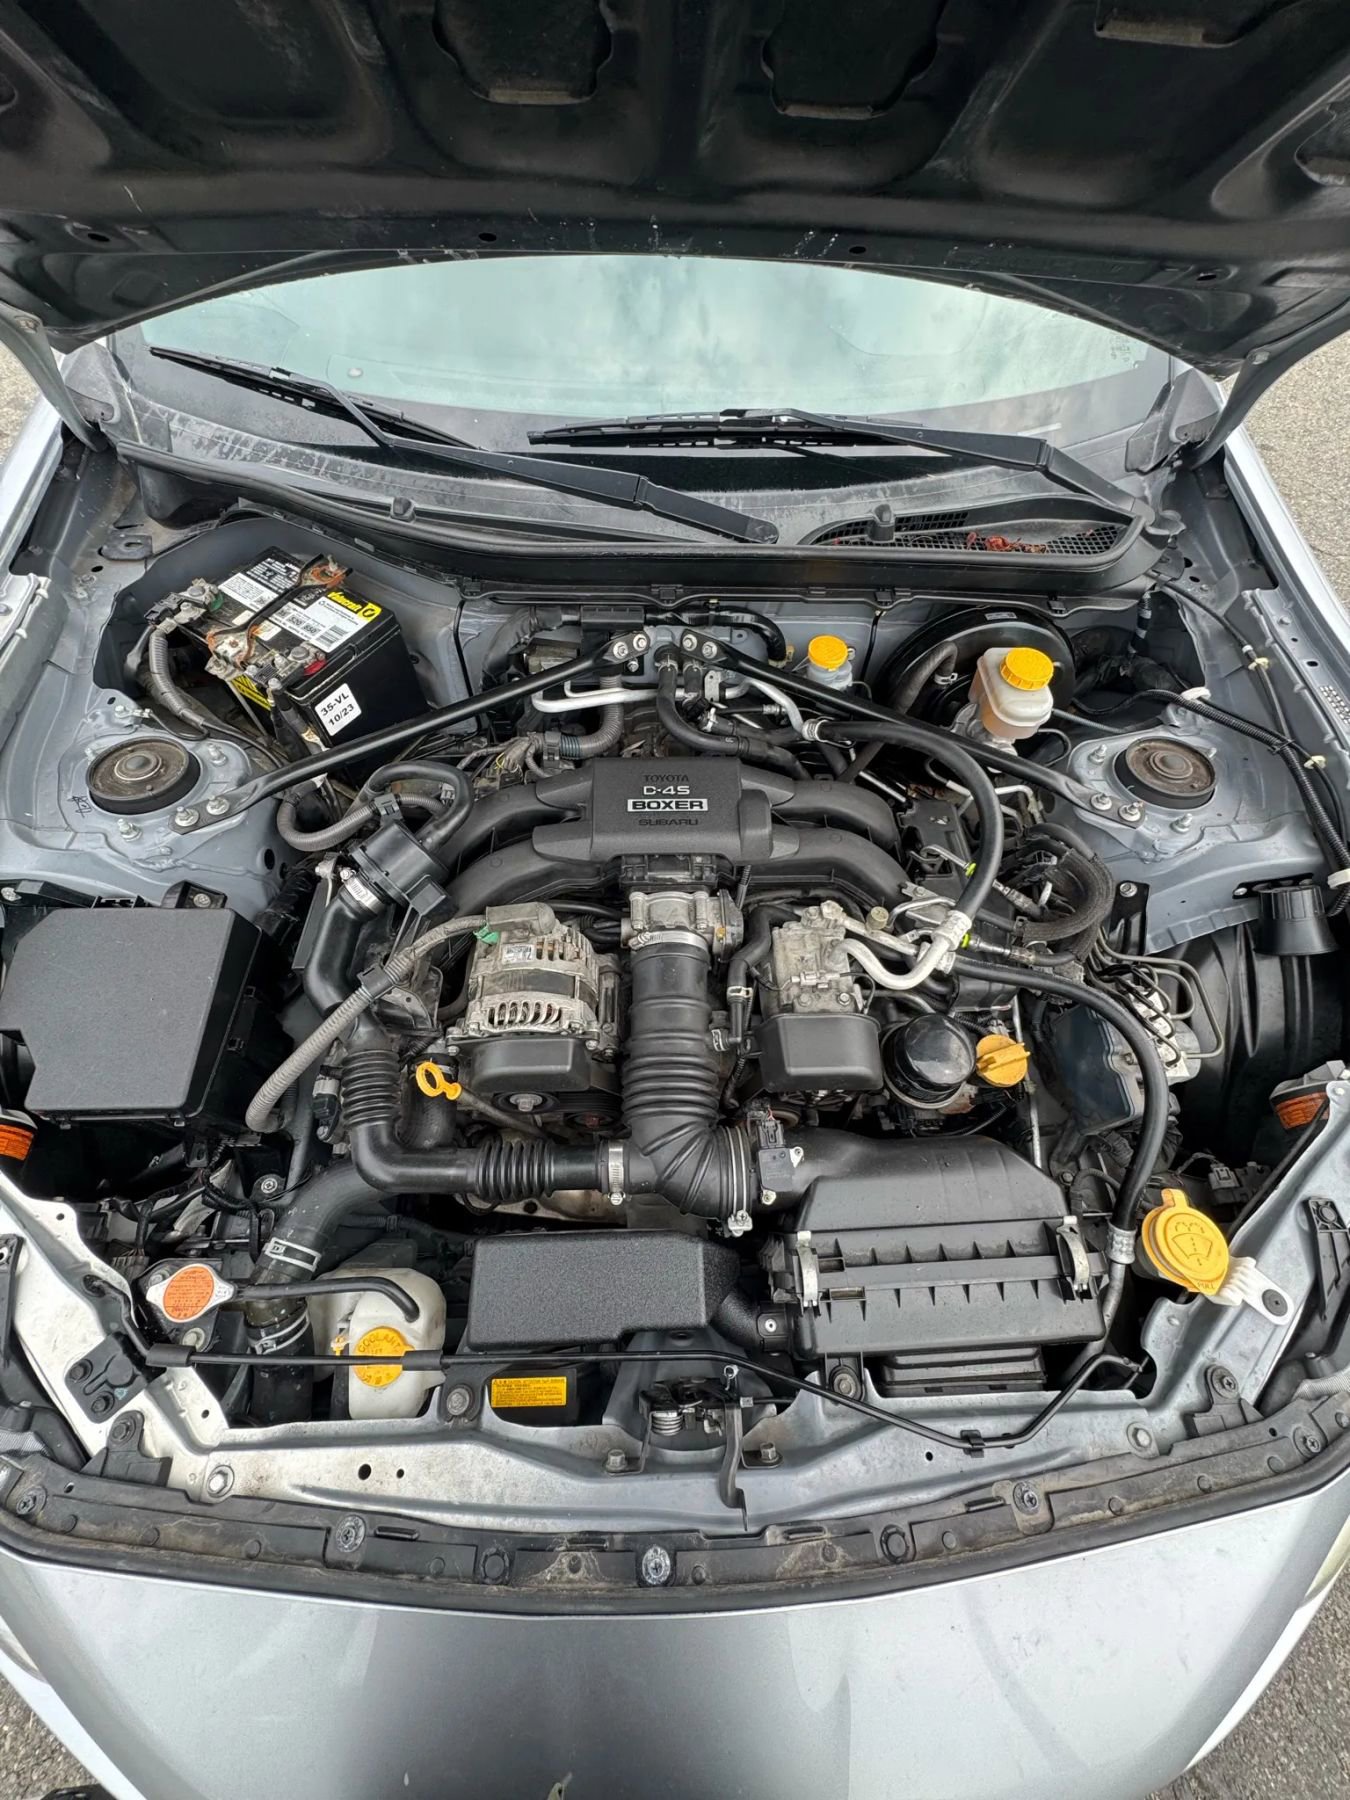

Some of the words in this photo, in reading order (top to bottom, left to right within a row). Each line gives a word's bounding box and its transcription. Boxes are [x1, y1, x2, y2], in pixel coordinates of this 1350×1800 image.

[320, 692, 349, 716] 35-VL
[329, 703, 354, 726] 10/23
[643, 774, 689, 782] TOYOTA
[643, 785, 690, 795] D-4S
[632, 800, 704, 810] BOXER
[638, 818, 699, 826] SUBARU
[358, 1332, 401, 1353] COOLANT
